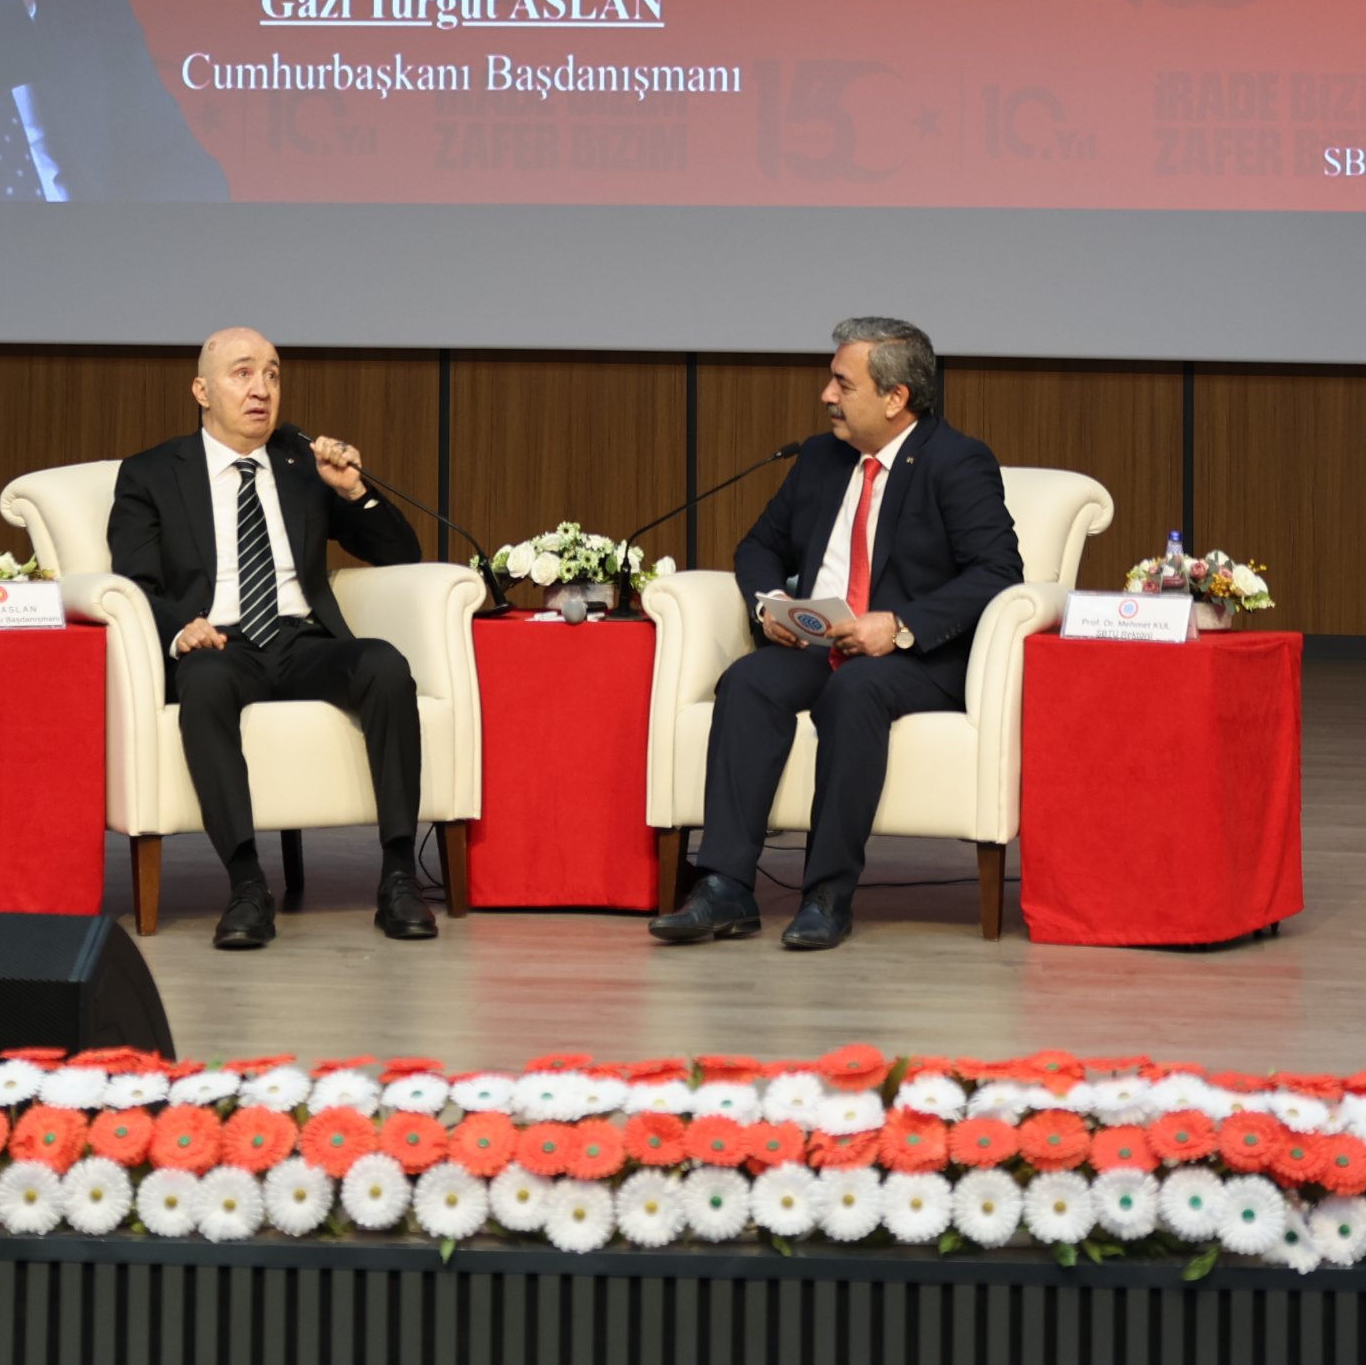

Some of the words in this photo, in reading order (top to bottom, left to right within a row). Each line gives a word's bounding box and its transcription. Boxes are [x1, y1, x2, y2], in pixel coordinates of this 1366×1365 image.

[182, 52, 470, 99] Cumhurbaşkanı
[486, 54, 741, 101] Başdanışmanı
[1, 605, 38, 614] ASLAN
[1118, 620, 1152, 629] Mehmet
